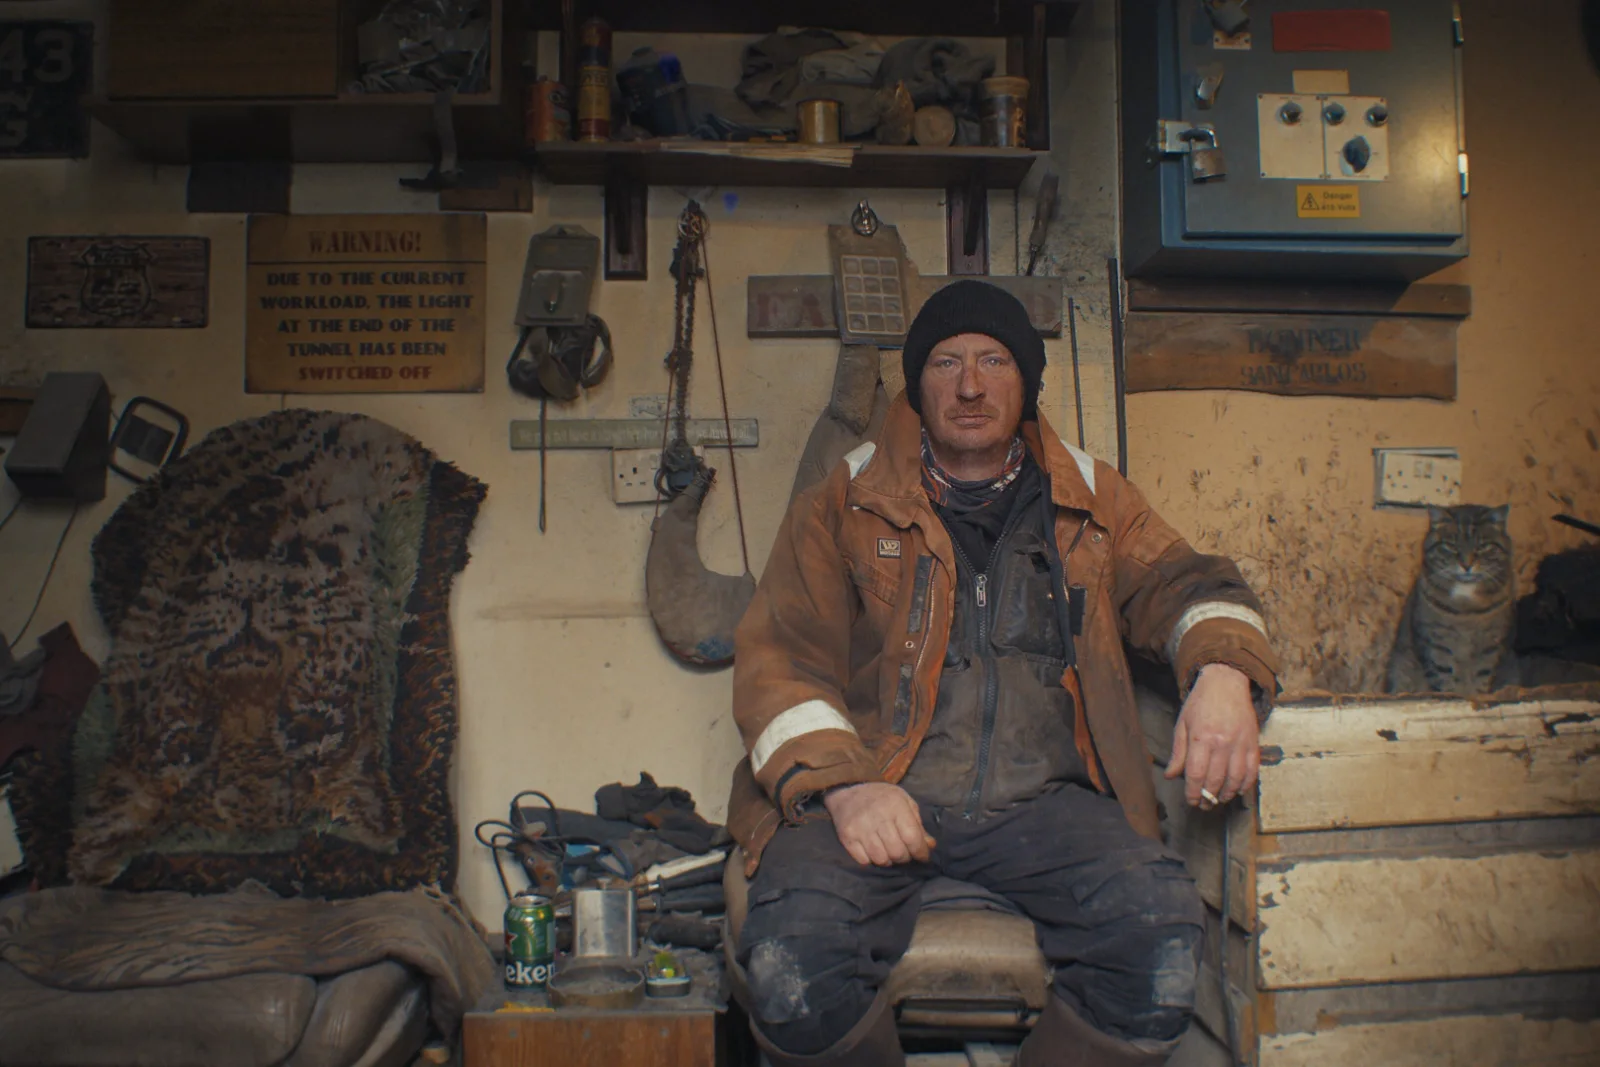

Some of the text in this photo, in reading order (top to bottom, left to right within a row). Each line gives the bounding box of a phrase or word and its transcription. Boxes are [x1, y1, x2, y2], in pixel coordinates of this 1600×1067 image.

[1322, 191, 1353, 200] Danger
[308, 230, 423, 254] WARNING!
[267, 271, 466, 286] DUE TO THE CURRENT
[376, 295, 412, 308] THE
[418, 295, 474, 308] LIGHT
[277, 318, 456, 333] AT THE END OF THE
[287, 342, 447, 357] TUNNEL HAS BEEN
[298, 366, 433, 380] SWITCHED OFF
